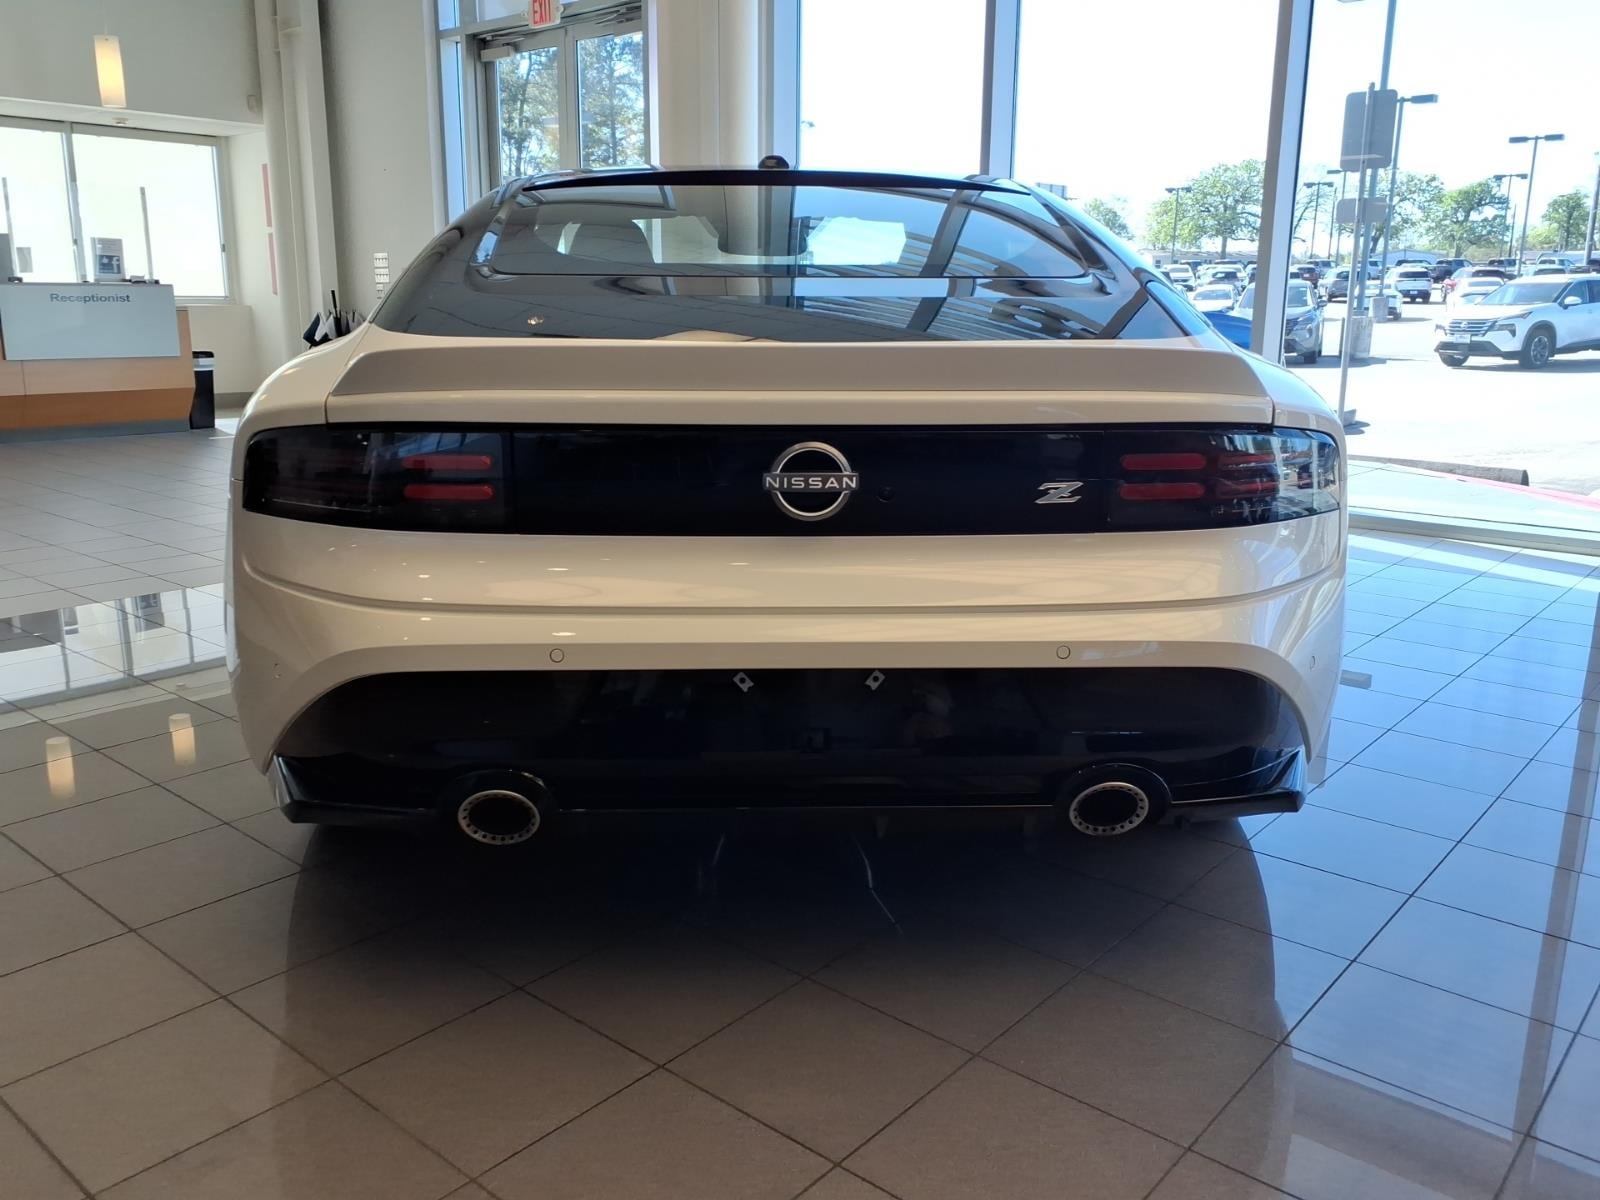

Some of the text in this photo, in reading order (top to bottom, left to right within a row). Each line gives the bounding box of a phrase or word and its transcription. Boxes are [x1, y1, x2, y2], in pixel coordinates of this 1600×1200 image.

[49, 293, 131, 304] Receptionist
[765, 476, 857, 489] NISSAN
[1034, 481, 1084, 504] Z
